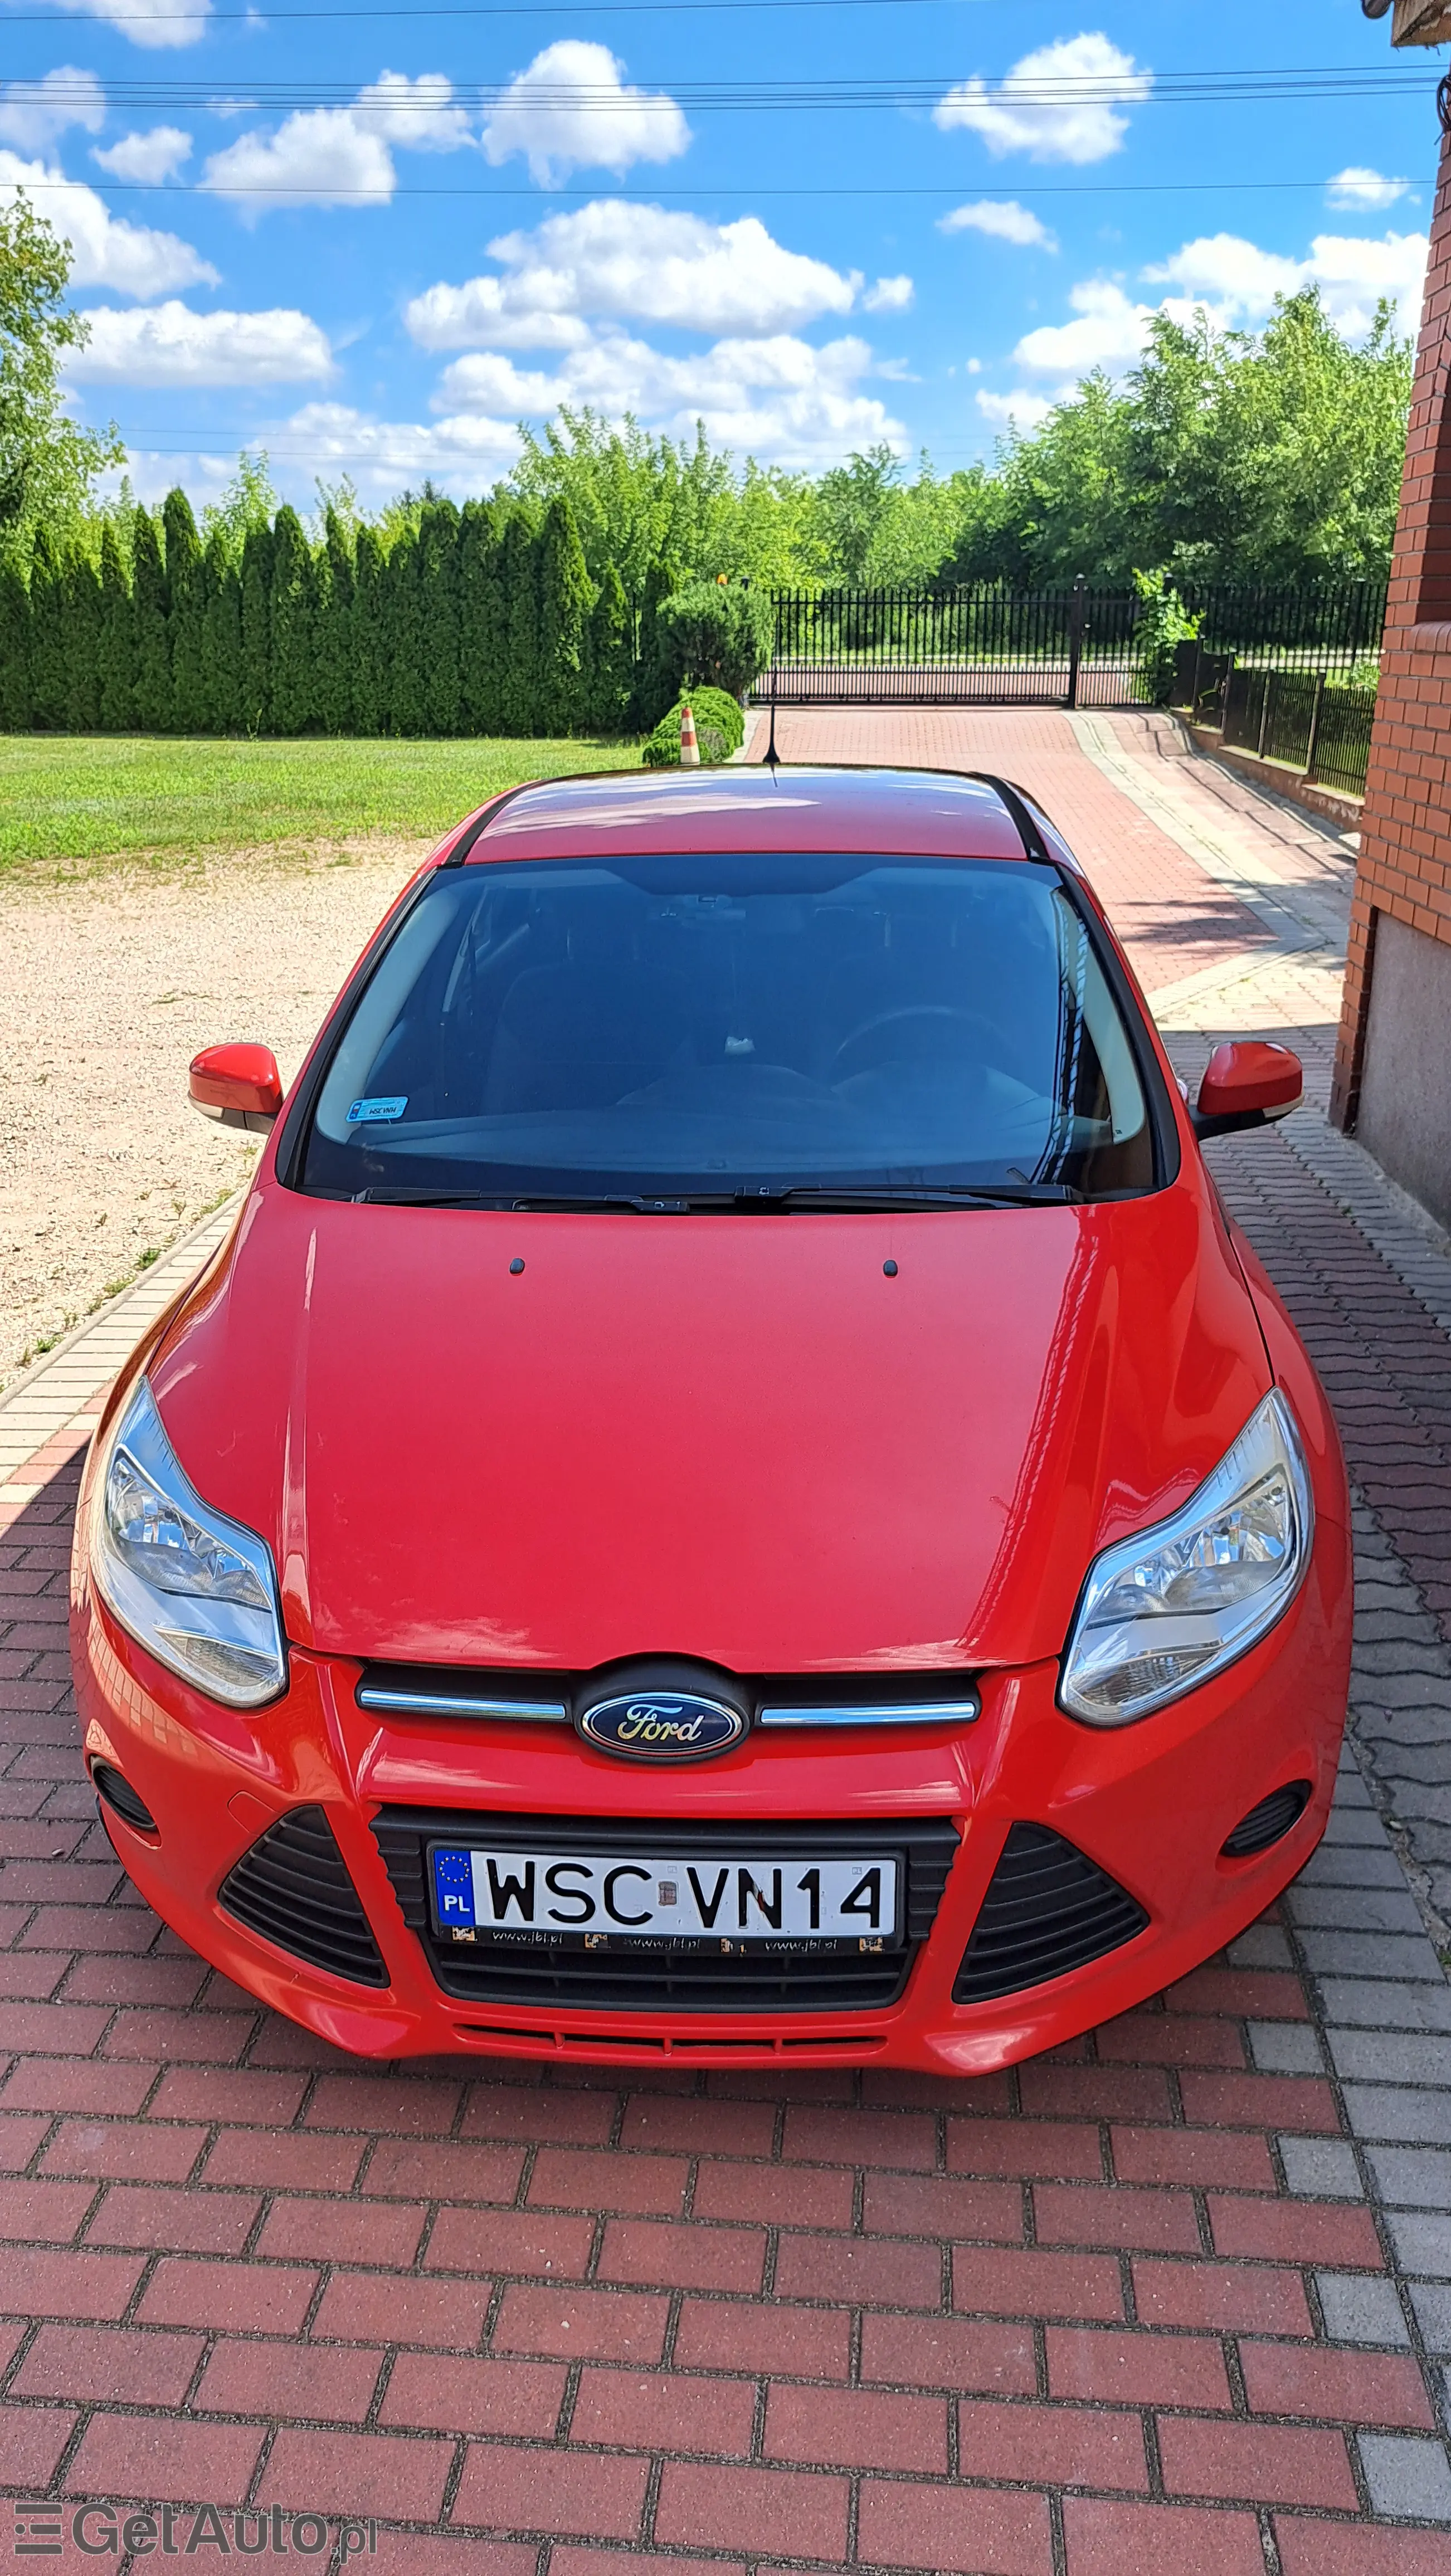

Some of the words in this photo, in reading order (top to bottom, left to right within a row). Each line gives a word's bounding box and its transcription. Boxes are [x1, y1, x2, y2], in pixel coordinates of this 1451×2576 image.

[617, 1704, 704, 1740] Ford
[486, 1858, 653, 1925] WSC
[686, 1867, 880, 1929] VN14
[444, 1895, 470, 1913] PL
[630, 1937, 700, 1951] www.jblpl
[765, 1939, 837, 1953] www.jblpl
